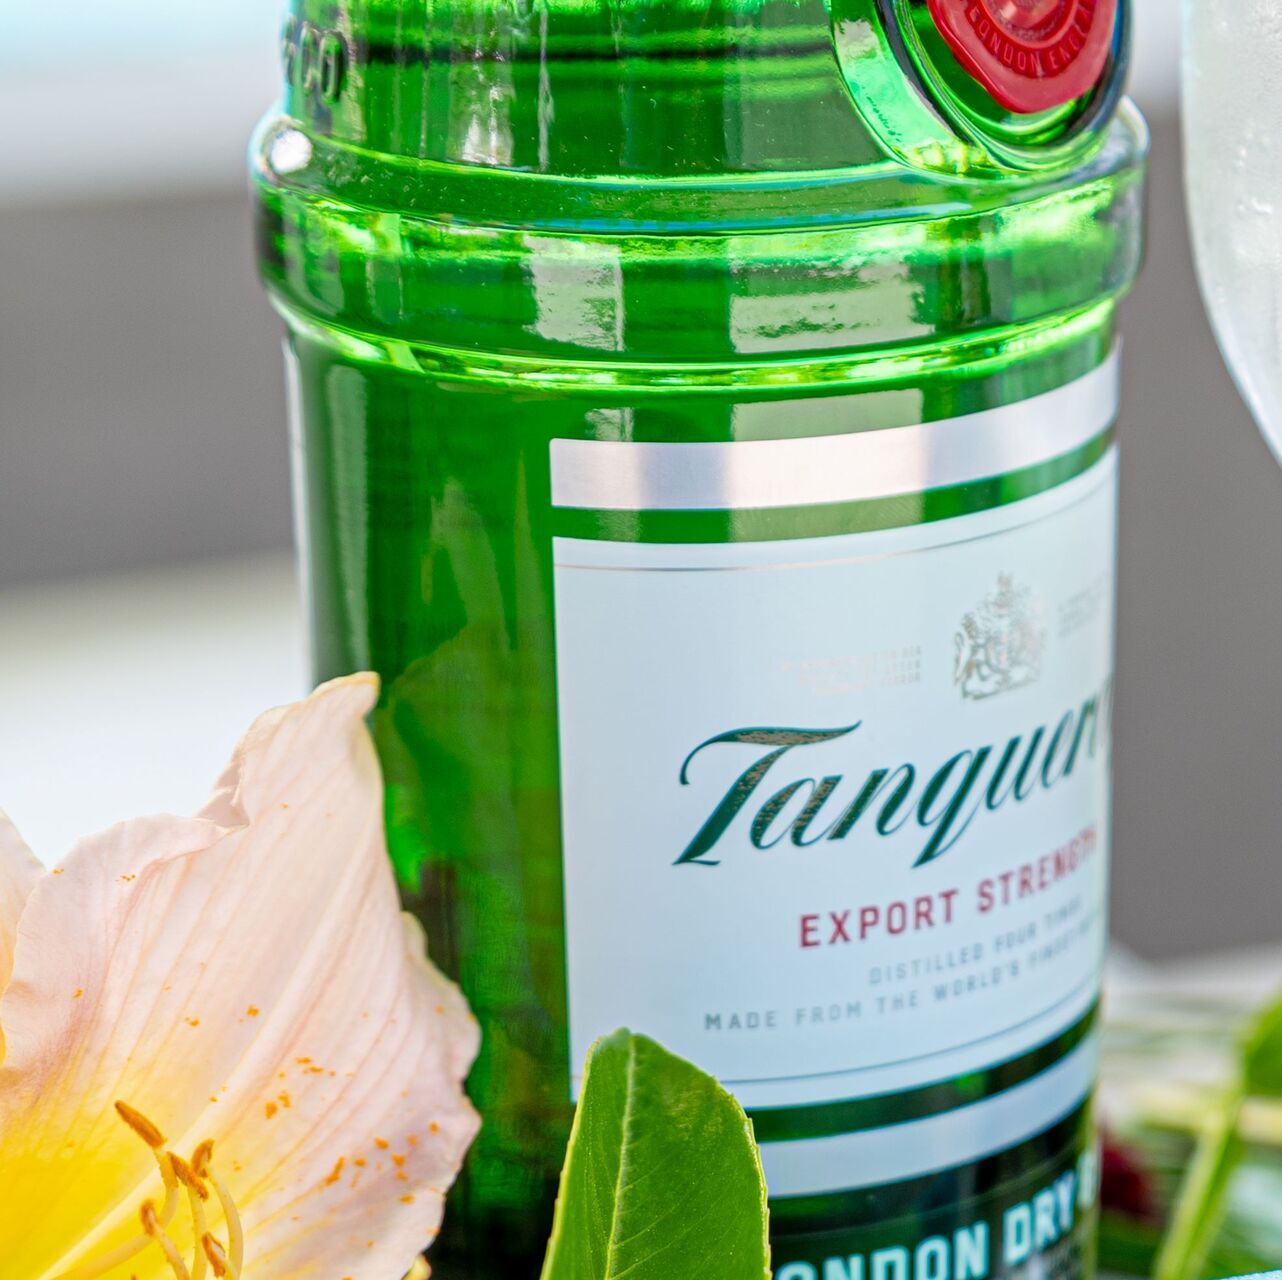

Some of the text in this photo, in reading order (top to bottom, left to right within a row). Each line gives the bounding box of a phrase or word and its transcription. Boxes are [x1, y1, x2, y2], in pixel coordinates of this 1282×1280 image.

[672, 696, 1100, 867] Tanquer
[799, 889, 959, 949] EXPORT
[868, 941, 985, 986] DISTILLED
[993, 921, 1038, 953] FOUR
[704, 1009, 778, 1032] MADE
[796, 998, 864, 1028] FROM
[875, 988, 921, 1014] THE
[932, 958, 1021, 1003] WORLD'S
[1002, 1168, 1076, 1269] DRY
